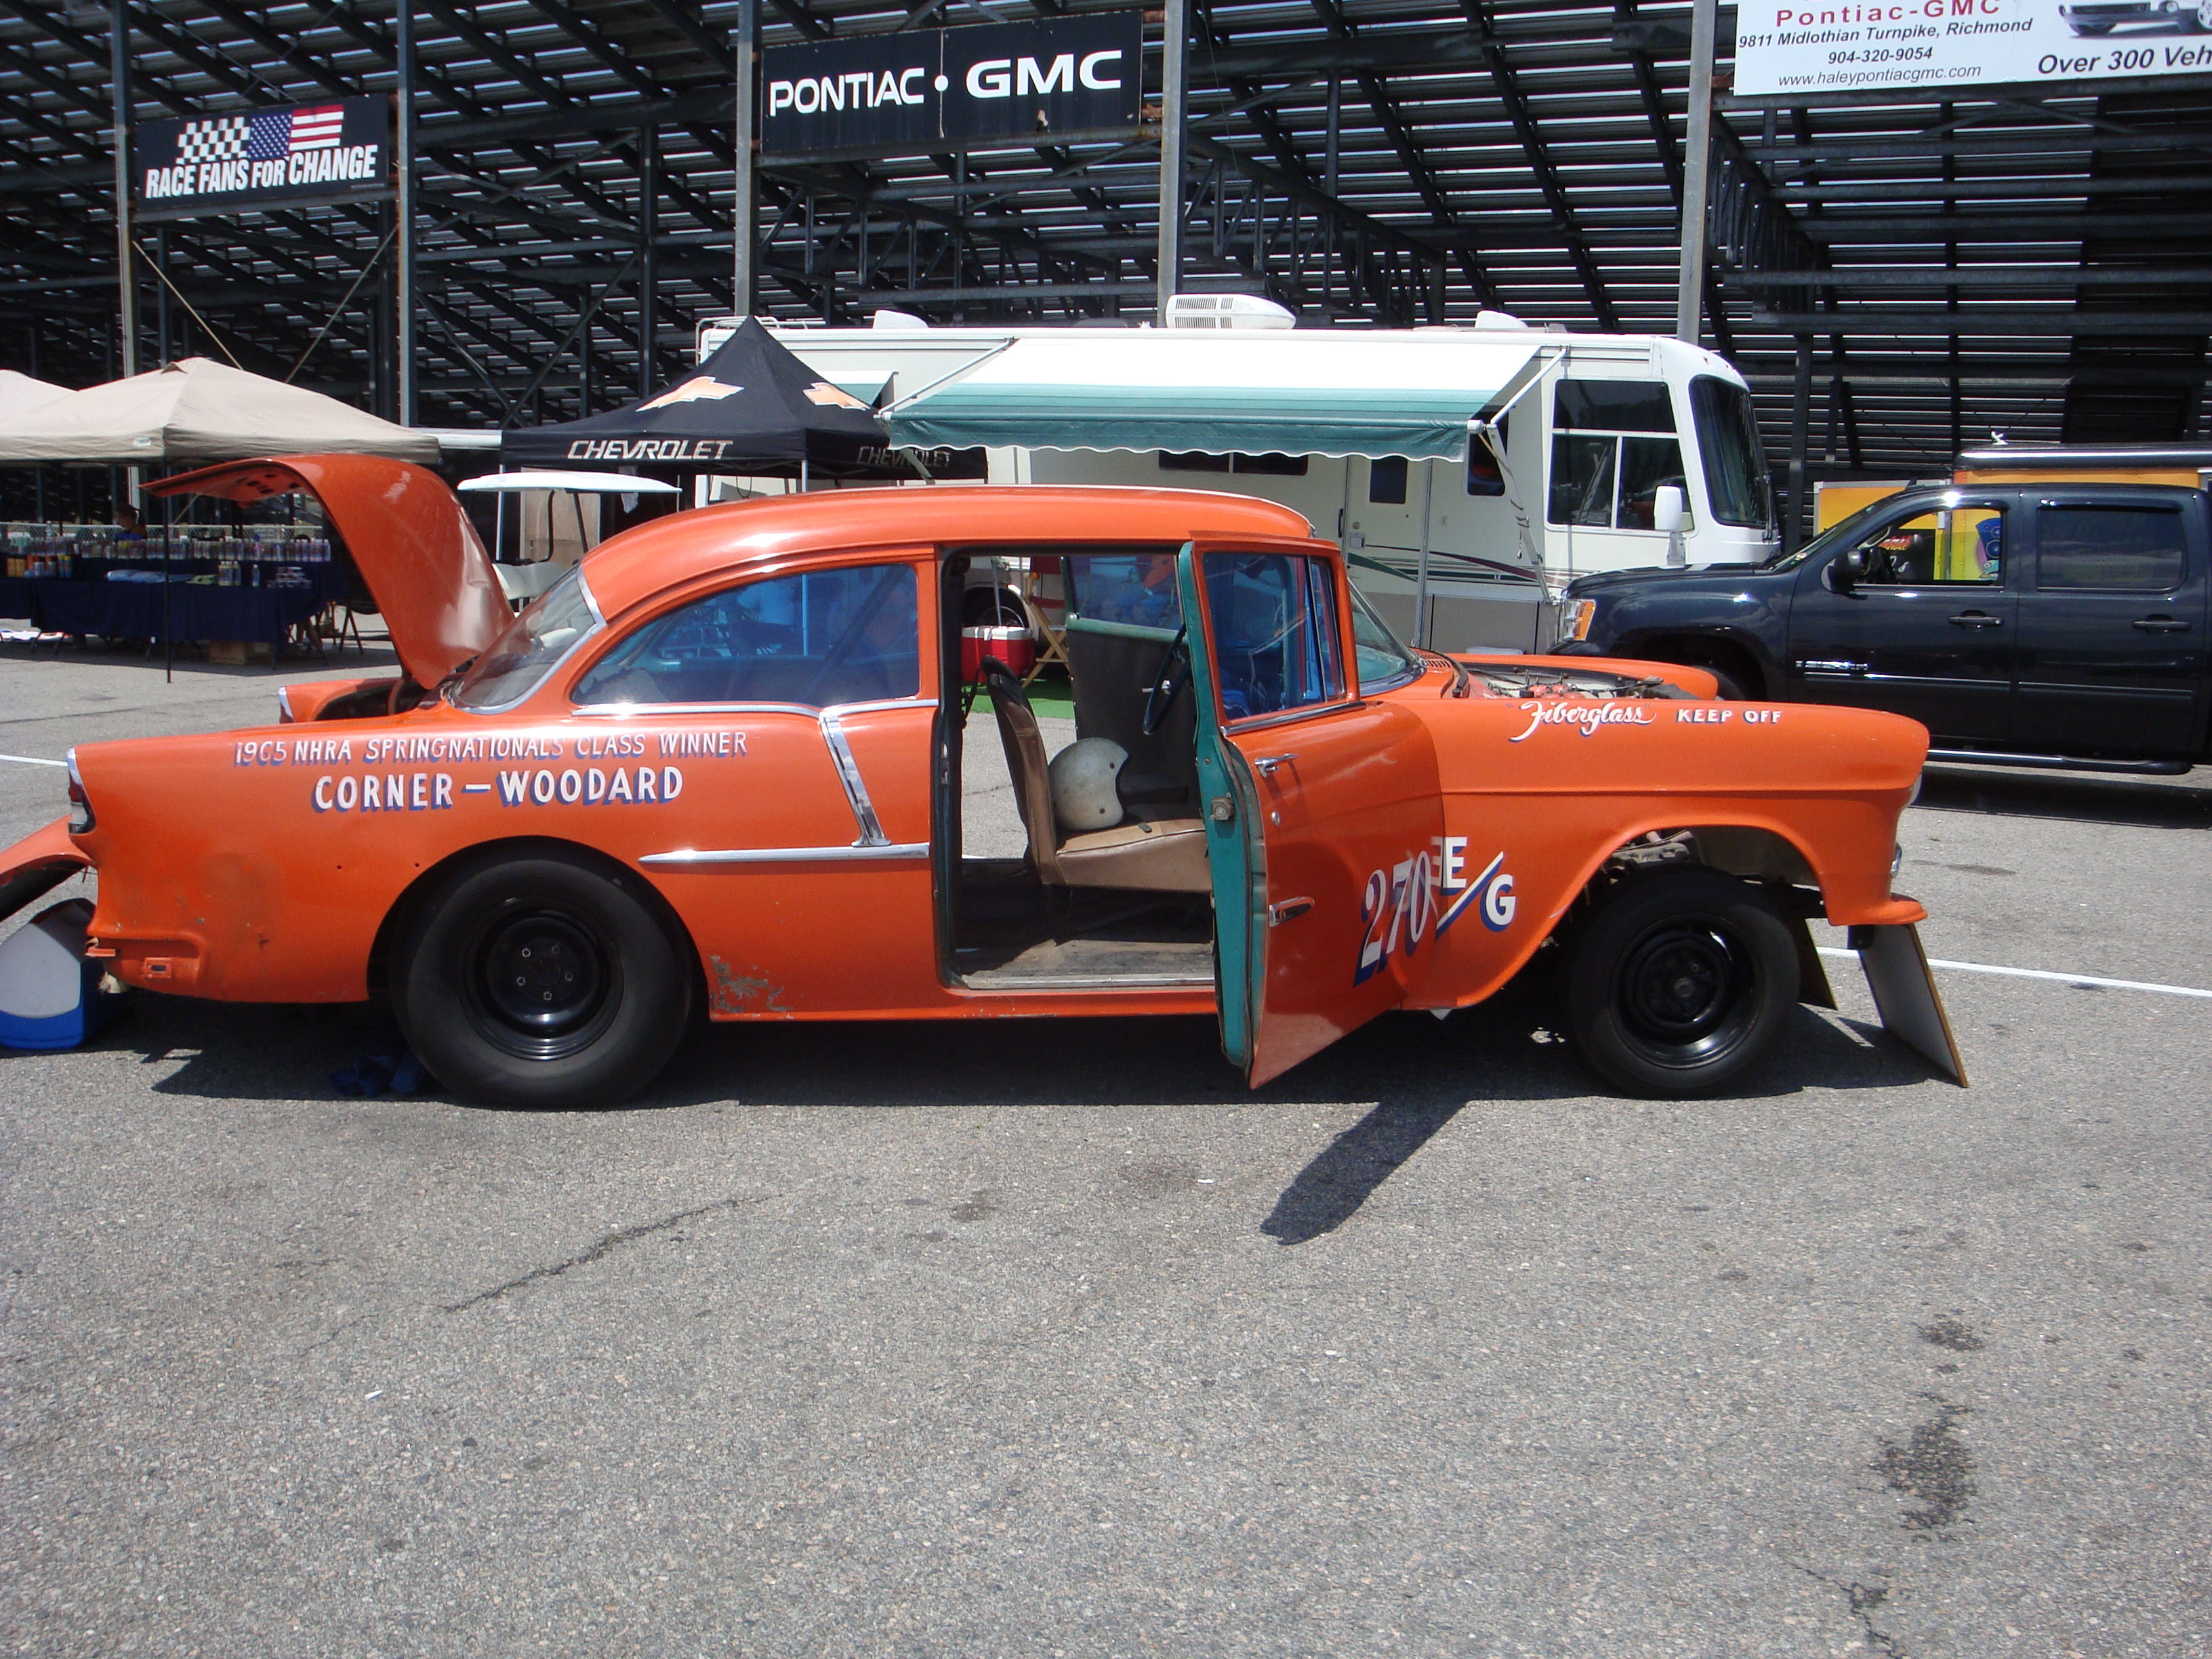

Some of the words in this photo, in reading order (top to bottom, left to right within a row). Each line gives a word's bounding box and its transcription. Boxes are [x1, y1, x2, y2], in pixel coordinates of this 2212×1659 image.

[1739, 33, 1773, 48] 9811
[1777, 30, 1859, 46] Midlothian
[1865, 24, 1940, 41] Turnpike,
[1946, 18, 2033, 36] Richmond
[1828, 46, 1933, 64] 904-320-9054
[2037, 54, 2100, 75] Over
[2108, 49, 2155, 70] 300
[770, 67, 924, 117] PONTIAC
[966, 49, 1122, 99] GMC
[1778, 66, 1982, 86] www.haleypontiacgmc.com
[145, 165, 196, 199] RACE
[198, 159, 249, 193] FANS
[251, 159, 285, 188] FOR
[289, 144, 378, 185] CHANGE
[567, 440, 733, 459] CHEVROLET
[1676, 708, 1732, 723] KEEP
[1743, 710, 1782, 724] OFF
[293, 739, 352, 766] NHRA
[364, 737, 564, 763] SPRINGNATIONALS
[574, 734, 646, 759] CLASS
[658, 731, 747, 758] WINNER
[311, 773, 453, 813] CORNER
[495, 766, 683, 807] WOODARD
[1355, 851, 1431, 981] 270
